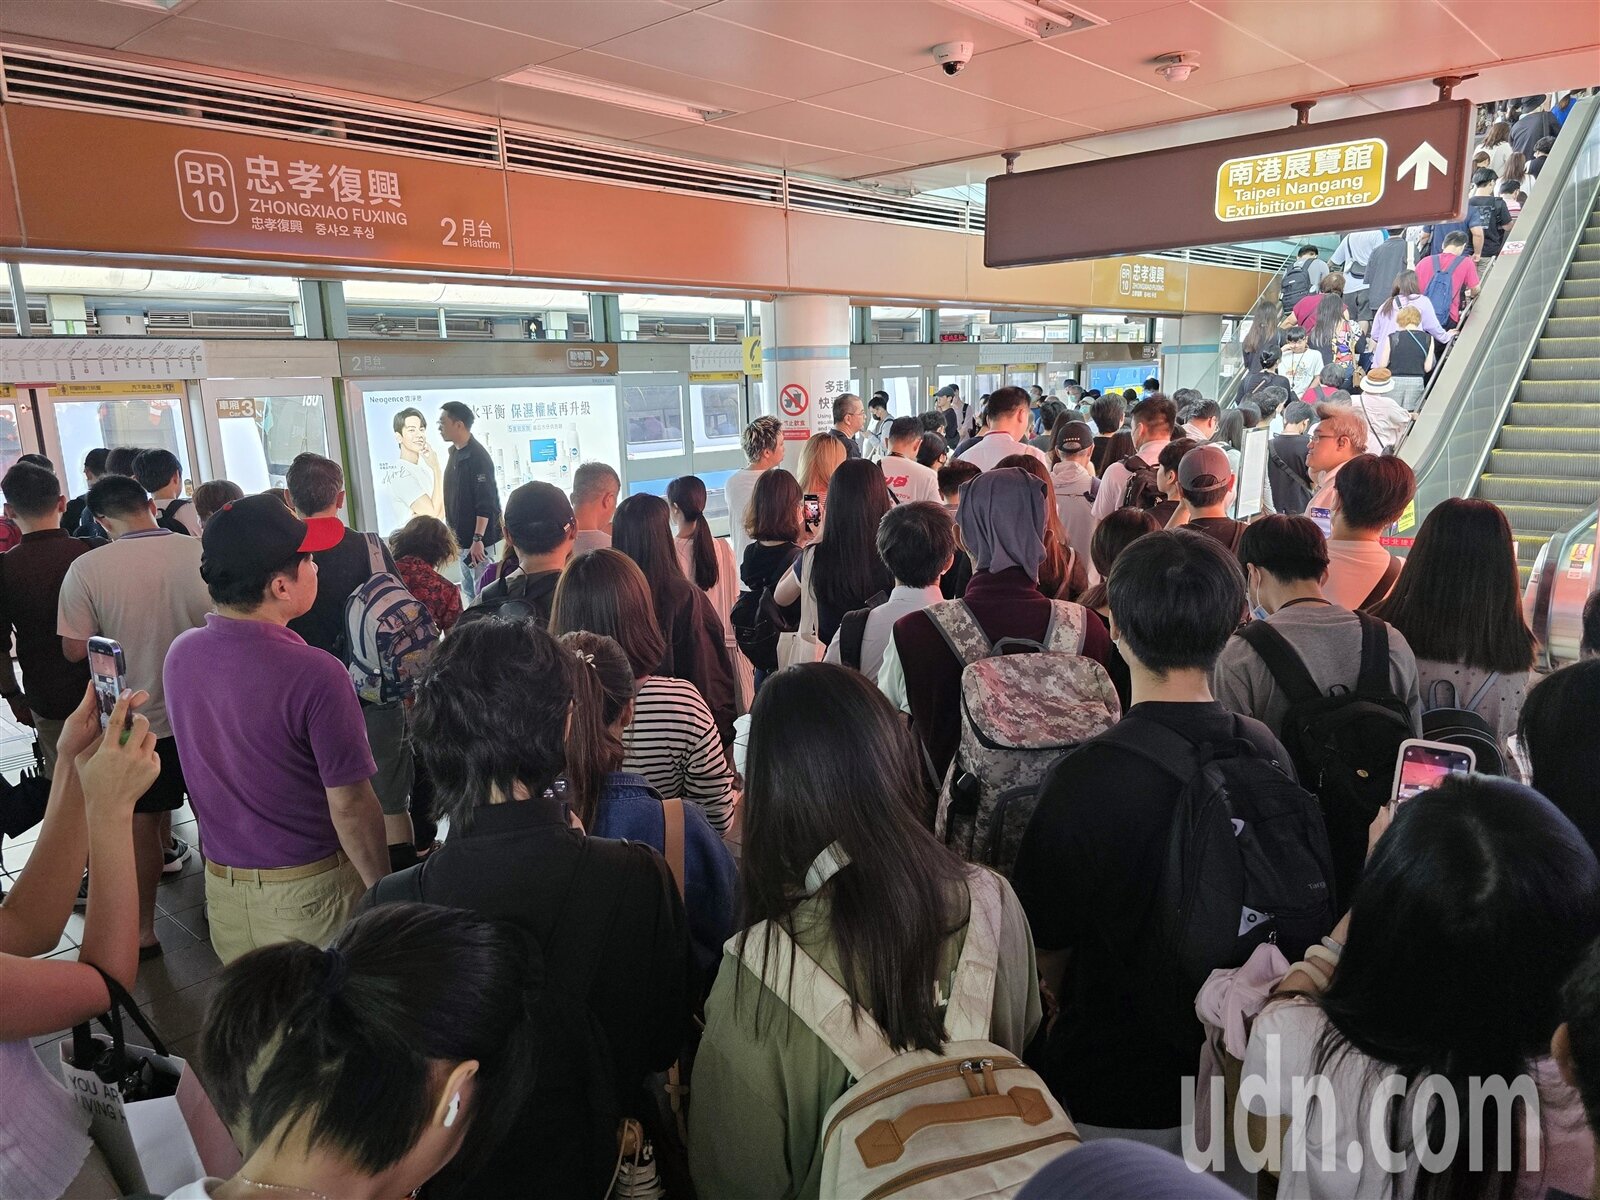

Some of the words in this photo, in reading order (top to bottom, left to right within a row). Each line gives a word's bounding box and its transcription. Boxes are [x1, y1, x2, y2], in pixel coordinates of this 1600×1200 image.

[184, 160, 227, 187] BR
[1228, 143, 1374, 187] 南港展覽館
[245, 154, 402, 208] 忠孝復興
[1233, 183, 1281, 202] Taipei
[1285, 175, 1364, 195] Nangang
[192, 189, 225, 214] 10
[249, 198, 348, 221] ZHONGXIAO
[352, 208, 408, 226] FUXING
[1225, 198, 1305, 219] Exhibition
[1310, 191, 1371, 208] Center
[251, 217, 303, 234] 忠孝復興
[315, 223, 350, 237] 중샤오
[353, 226, 375, 240] 푸싱
[441, 217, 458, 247] 2
[462, 218, 492, 238] 月台
[463, 237, 501, 249] Platform
[1132, 264, 1165, 283] 忠孝復興
[351, 356, 362, 371] 2
[241, 400, 254, 417] 3
[369, 396, 404, 404] Neogence
[69, 1074, 98, 1095] YOU
